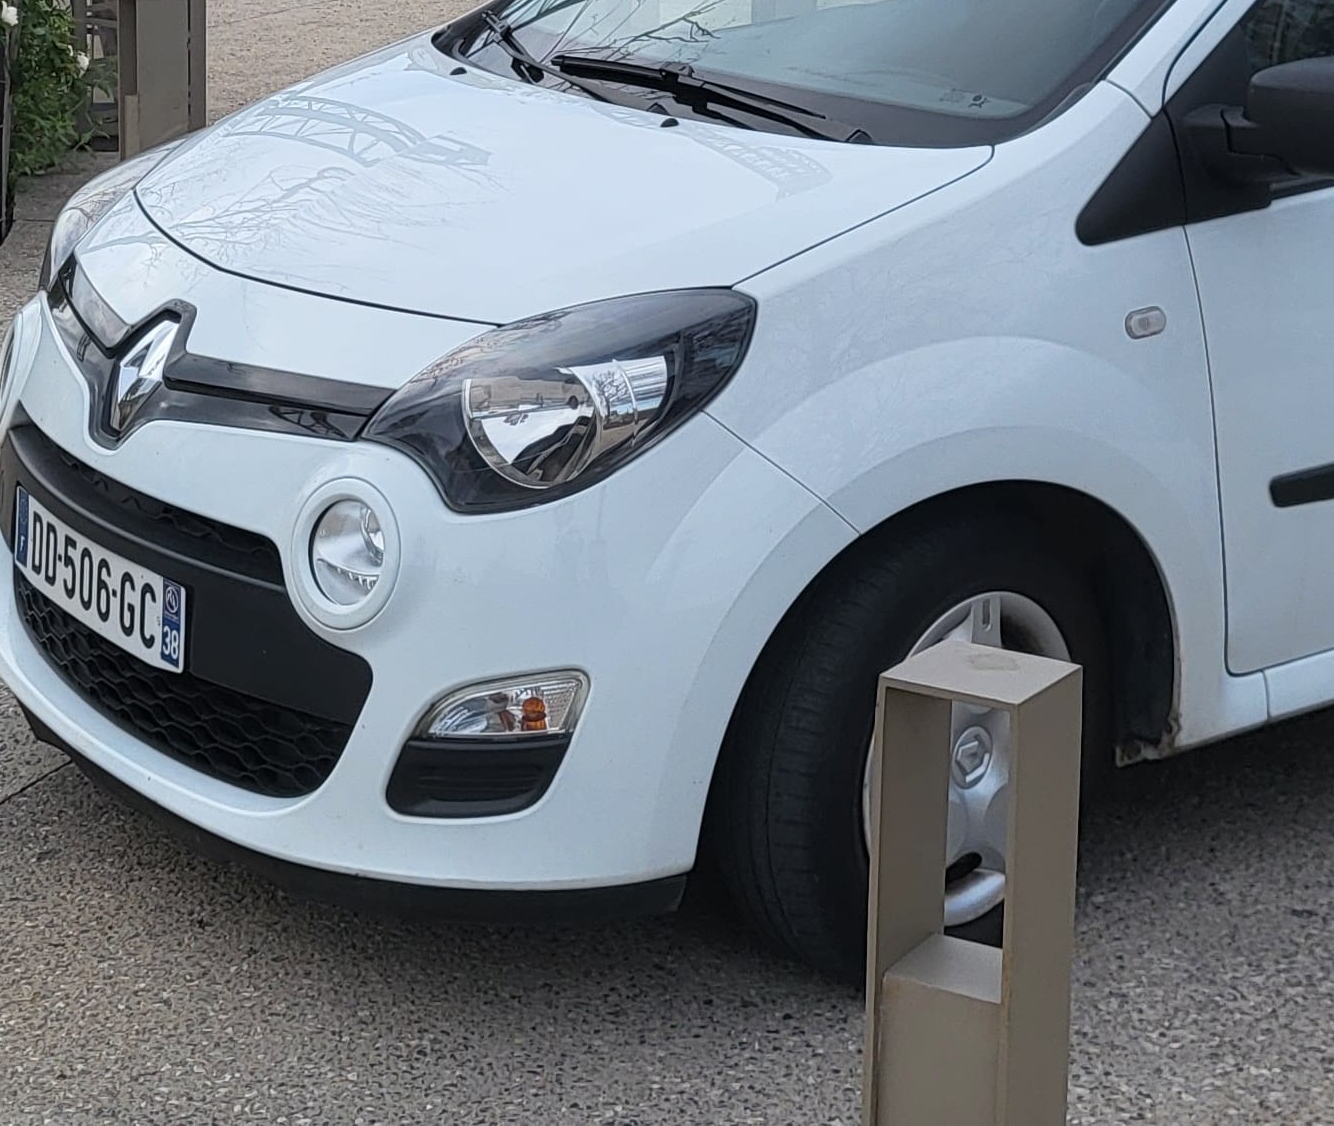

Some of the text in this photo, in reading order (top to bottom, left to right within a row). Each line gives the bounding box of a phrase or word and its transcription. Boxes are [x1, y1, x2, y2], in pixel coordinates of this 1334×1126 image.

[19, 510, 179, 660] F DD-506-GC 38
